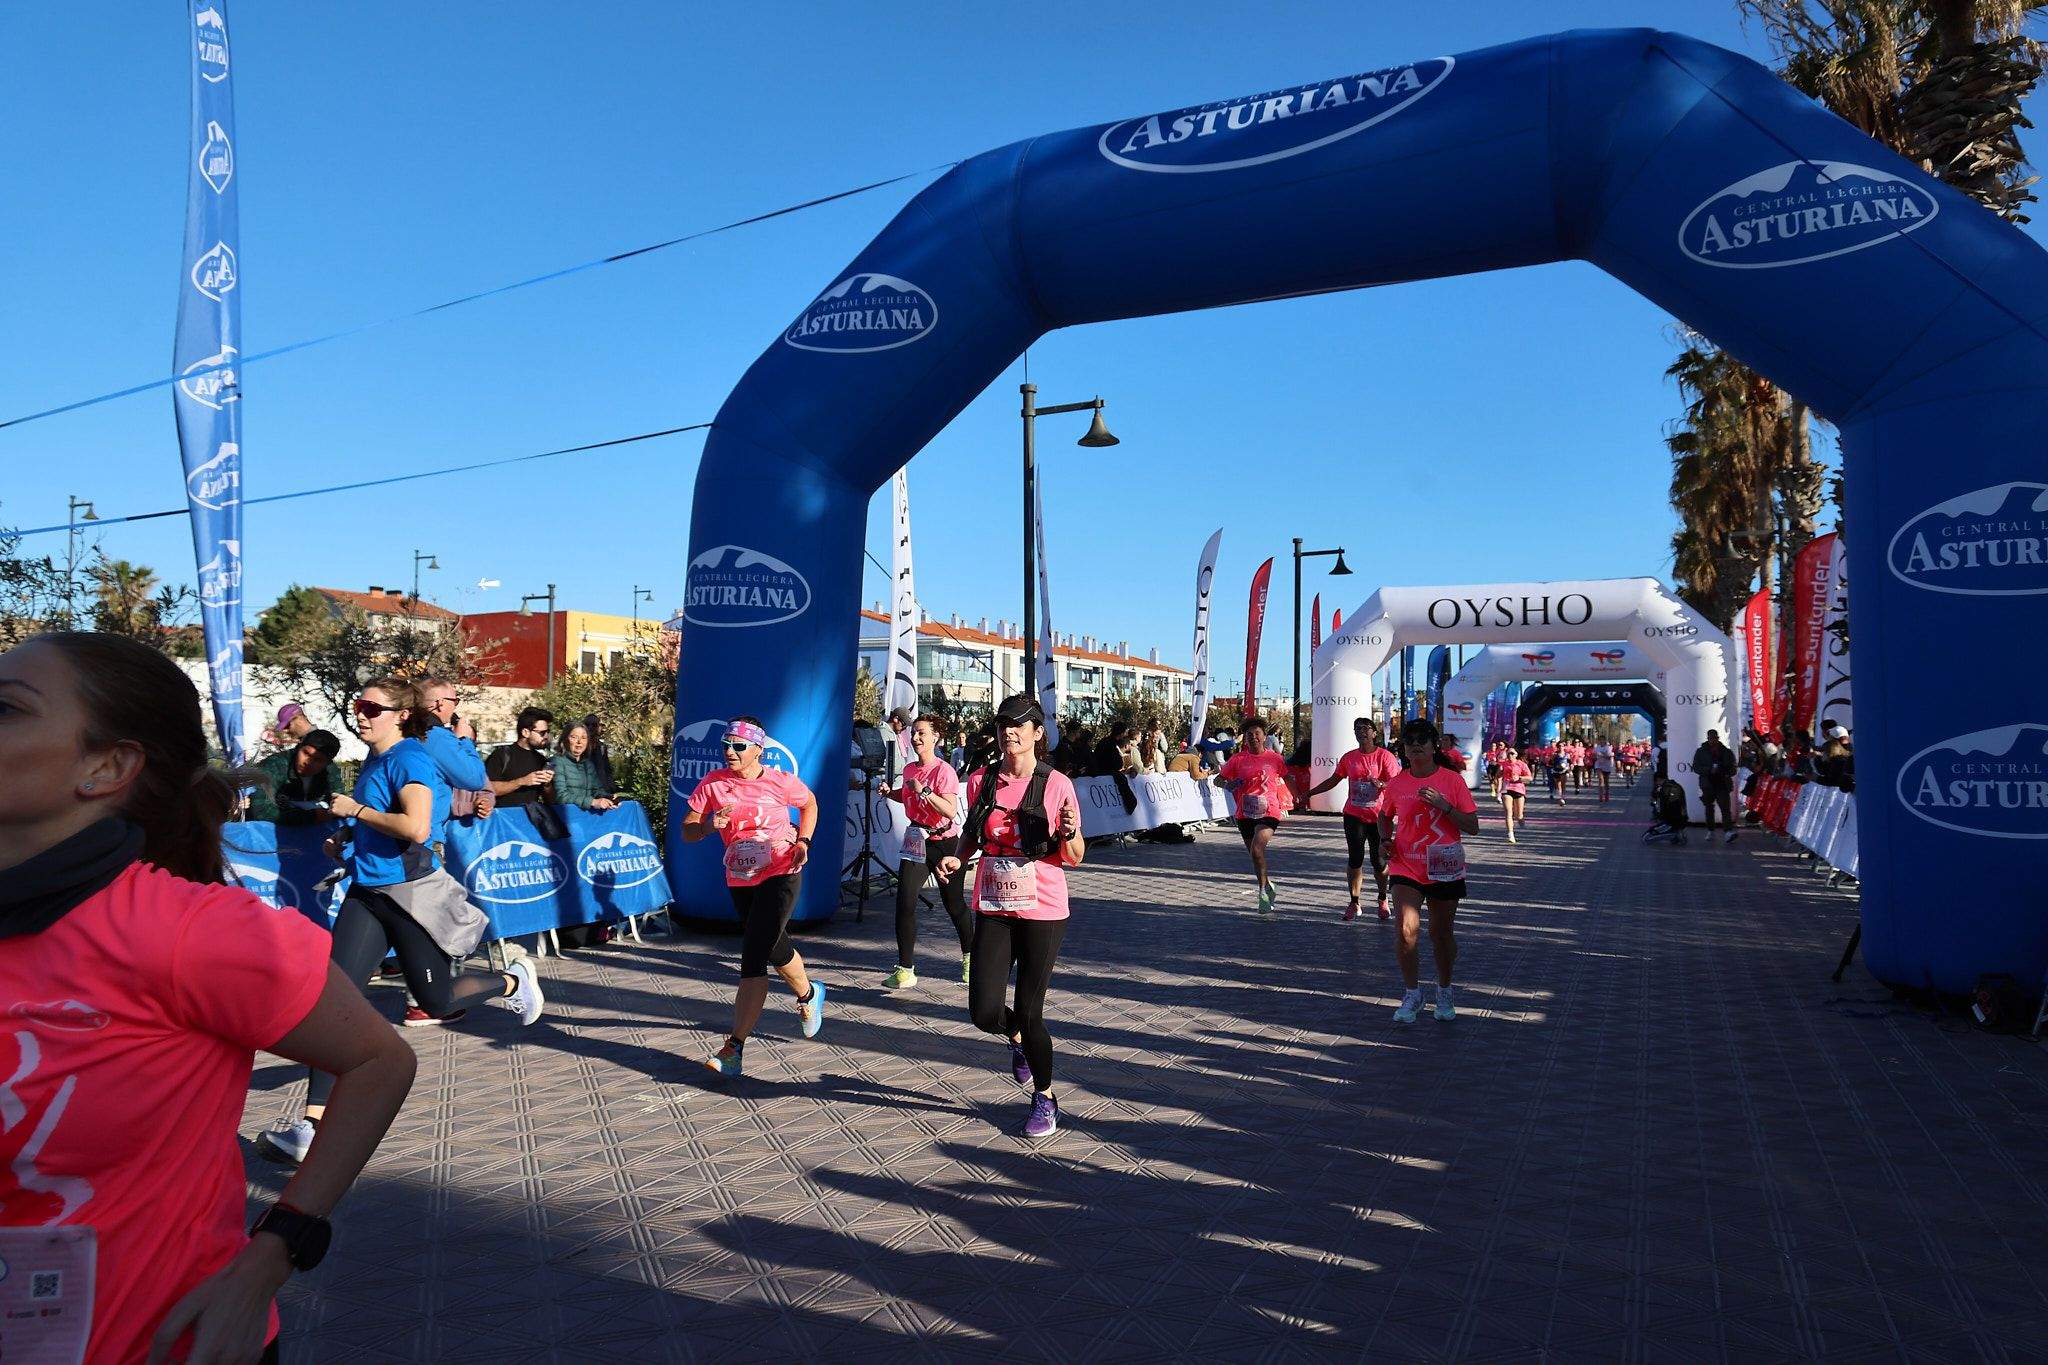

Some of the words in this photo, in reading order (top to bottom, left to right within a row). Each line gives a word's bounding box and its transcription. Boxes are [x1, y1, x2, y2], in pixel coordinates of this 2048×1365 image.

[1120, 66, 1424, 154] ASTURIANA
[1733, 192, 1818, 217] CENTRAL
[1826, 184, 1908, 199] LECHERA
[1698, 196, 1925, 255] ASTURIANA
[816, 298, 860, 314] CENTRAL
[864, 295, 919, 306] LECHERA
[790, 308, 926, 340] ASTURIANA
[1941, 521, 2031, 537] CENTRAL
[1903, 531, 2048, 573] ASTUR
[694, 573, 733, 582] CENTRAL
[738, 573, 794, 586] LECHERA
[686, 577, 798, 610] ASTURIANA
[1428, 594, 1593, 629] OYSHO
[1336, 635, 1382, 646] OYSHO
[1645, 624, 1699, 638] OYSHO
[1752, 612, 1763, 686] Santander
[1315, 696, 1358, 707] OYSHO
[1558, 691, 1632, 699] VOLVO
[1951, 763, 2042, 774] CENTRAL
[1090, 784, 1122, 809] OYSH
[1145, 778, 1183, 804] OYSHO
[586, 854, 661, 878] ASTURIANA
[737, 856, 756, 866] 016
[474, 866, 563, 892] ASTURIANA
[996, 880, 1018, 891] 016
